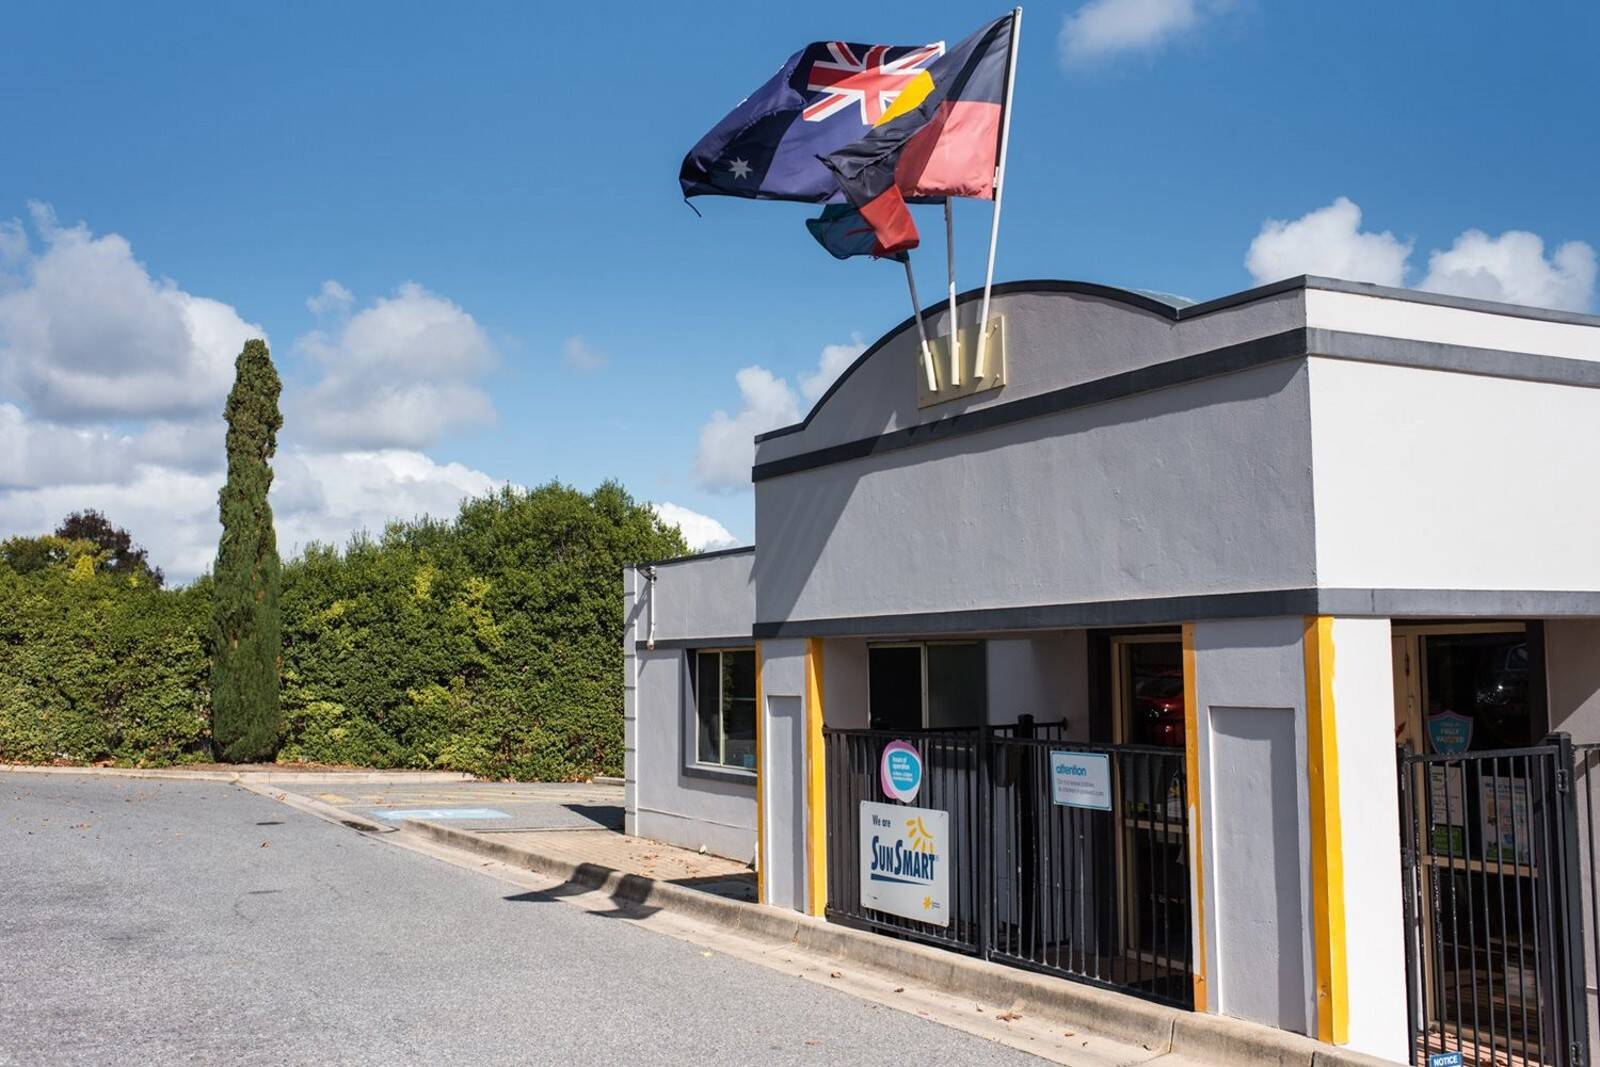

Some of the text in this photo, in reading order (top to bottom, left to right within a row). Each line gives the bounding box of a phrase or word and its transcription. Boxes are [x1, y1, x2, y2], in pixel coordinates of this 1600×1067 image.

[1056, 763, 1087, 777] attention
[872, 814, 891, 828] We are
[1433, 1054, 1458, 1067] NOTICE
